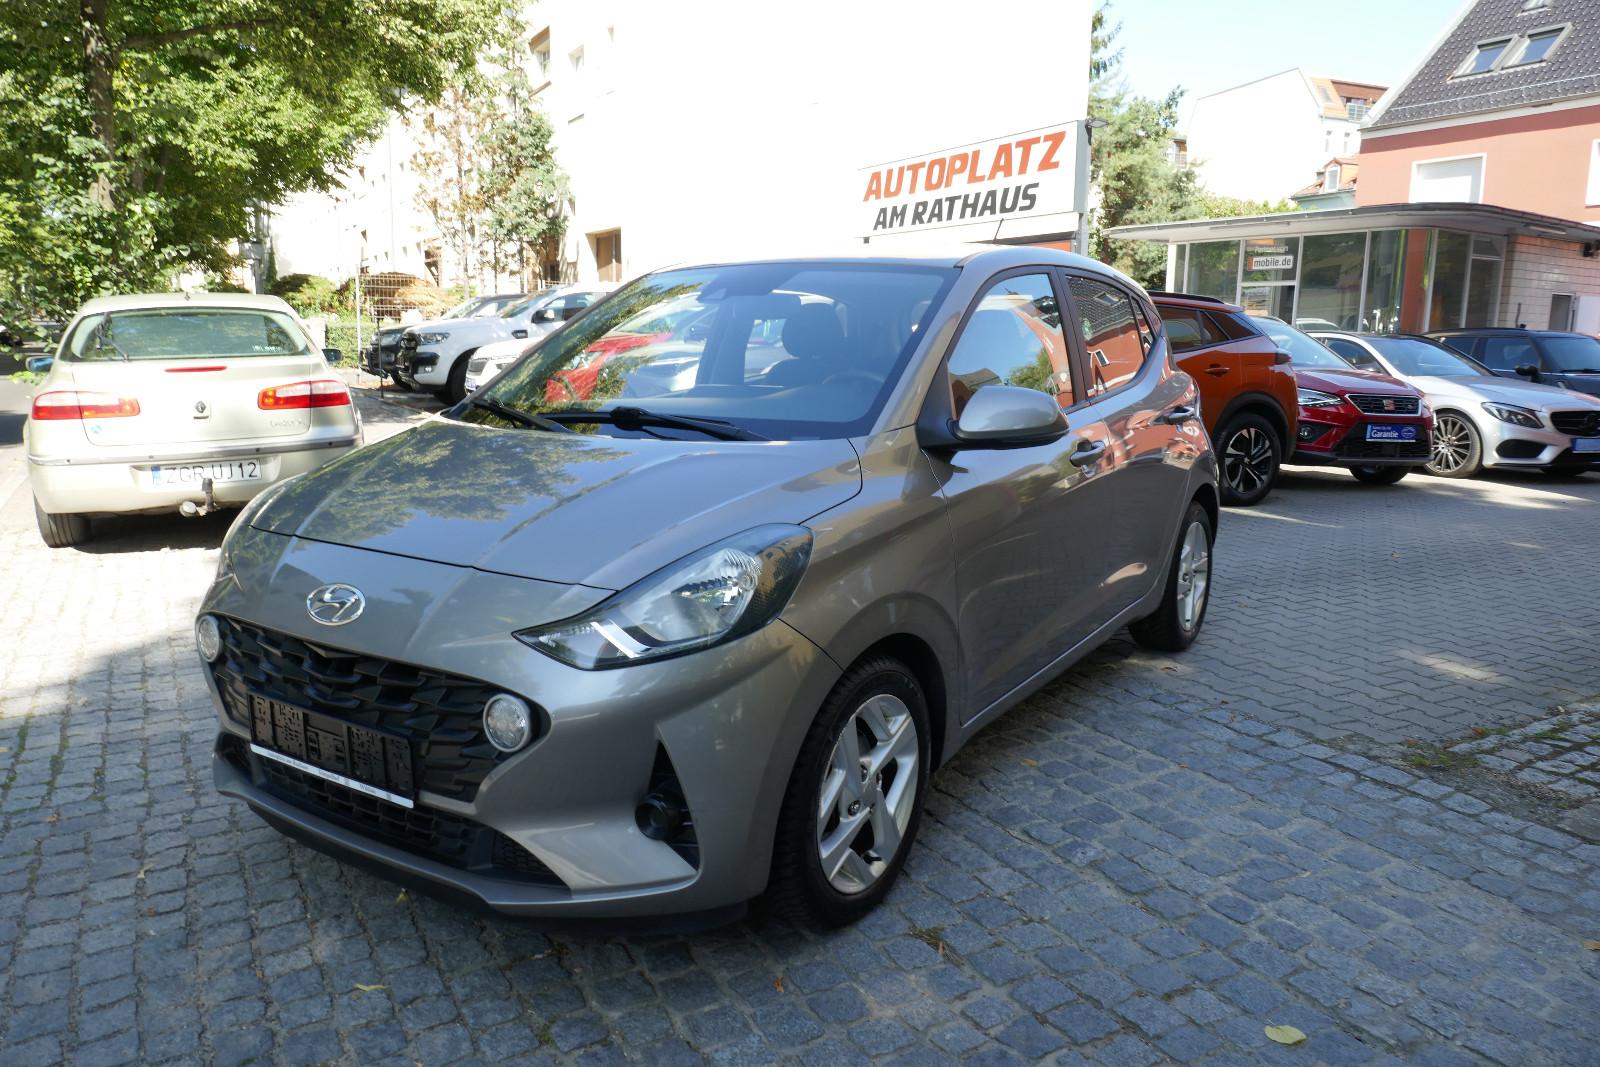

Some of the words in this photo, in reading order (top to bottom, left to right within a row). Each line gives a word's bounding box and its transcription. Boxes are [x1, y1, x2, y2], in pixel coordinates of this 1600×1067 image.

[863, 131, 1067, 202] AUTOPLATZ
[873, 203, 908, 231] AM
[911, 182, 1040, 226] RATHAUS
[1253, 257, 1292, 268] mobile.de
[1371, 430, 1399, 438] Garantie
[211, 461, 258, 480] UJ12
